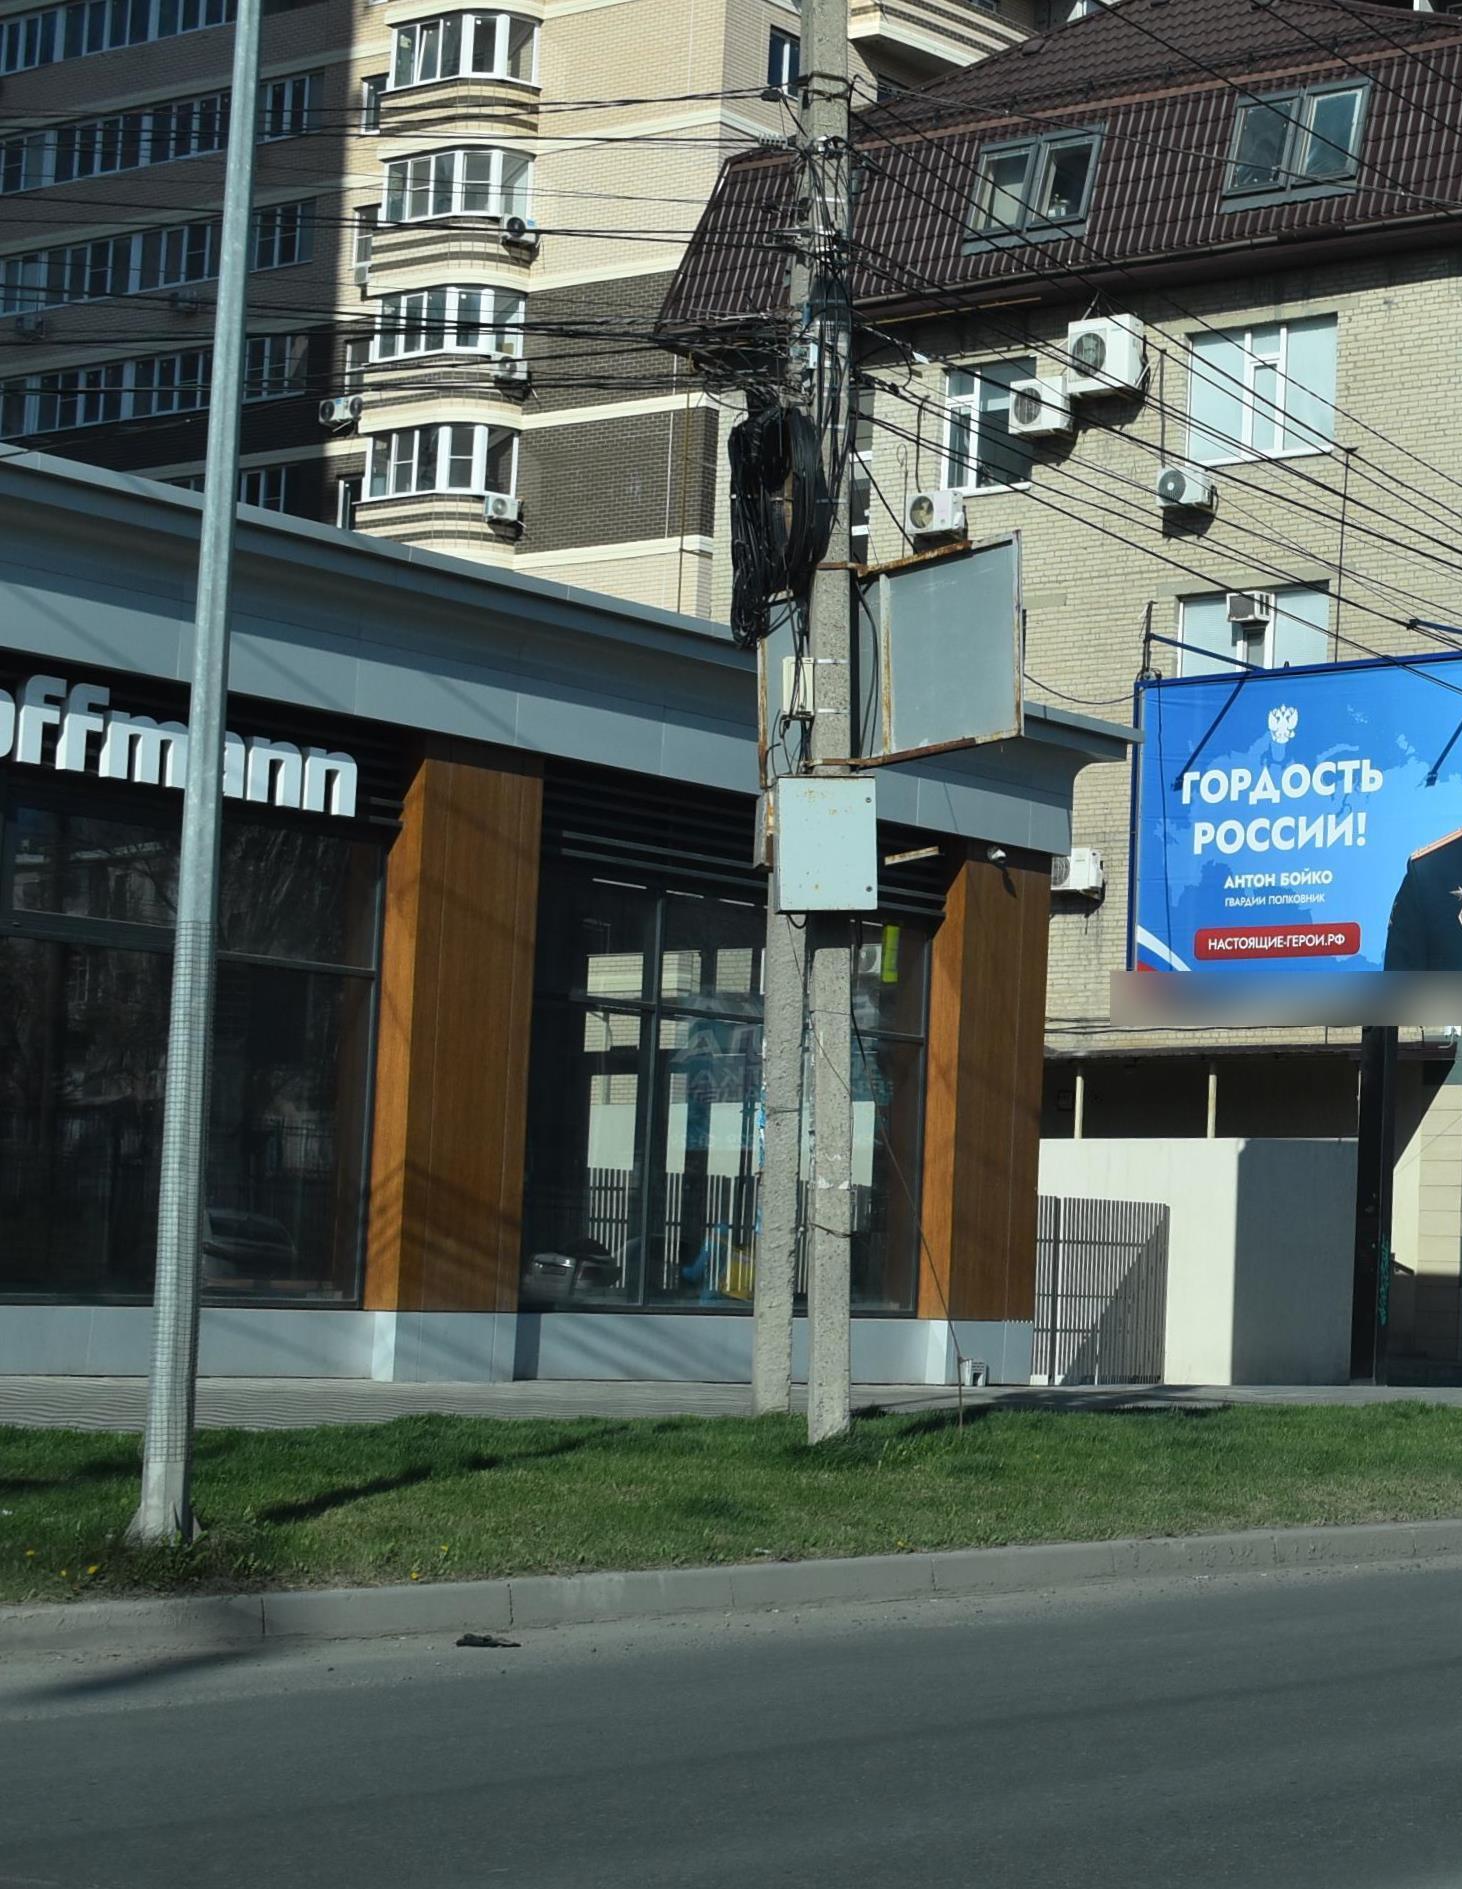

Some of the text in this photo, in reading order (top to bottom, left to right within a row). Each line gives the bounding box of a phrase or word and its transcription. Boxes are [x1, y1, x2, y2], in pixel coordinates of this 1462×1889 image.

[1181, 758, 1384, 805] ГОРДОСТЬ
[1193, 811, 1367, 855] РОССИИ!
[1224, 867, 1333, 889] АНТОН БОЙКО
[1224, 893, 1326, 908] ГВАРДИИ ПОЛКОВНИК
[1208, 933, 1346, 950] НАСТОЯЩИЕ-ГЕРОИ.РФ
